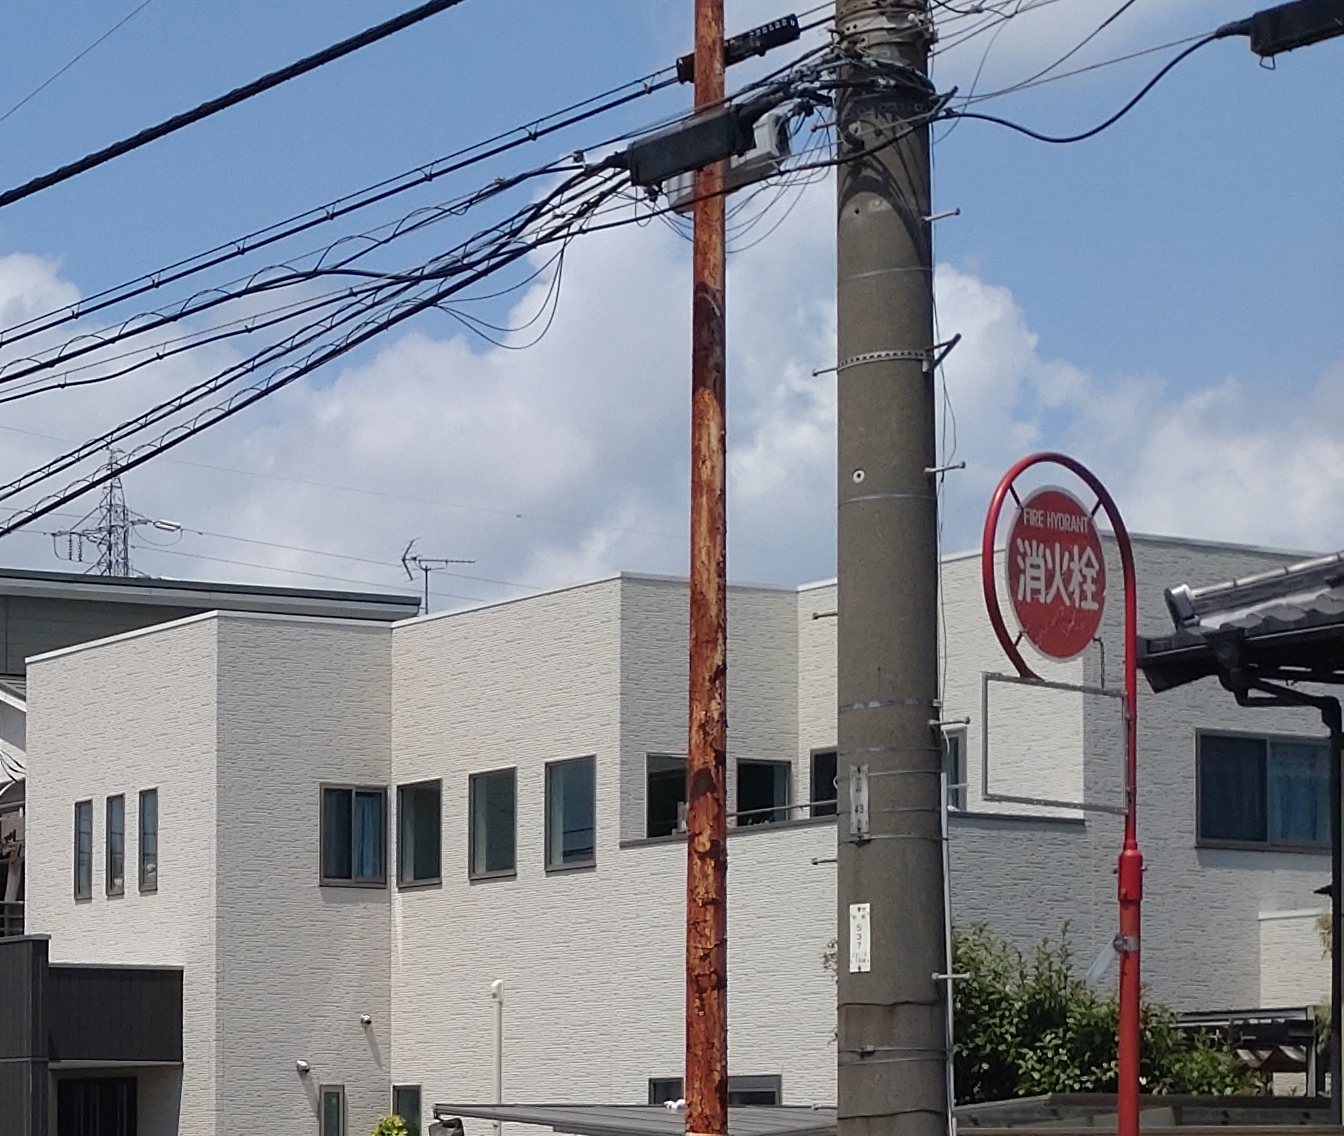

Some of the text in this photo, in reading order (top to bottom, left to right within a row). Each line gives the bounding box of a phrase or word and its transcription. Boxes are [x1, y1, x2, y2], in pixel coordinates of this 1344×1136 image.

[1023, 508, 1089, 534] FIRE HYDRANT
[1016, 537, 1099, 610] 消火栓
